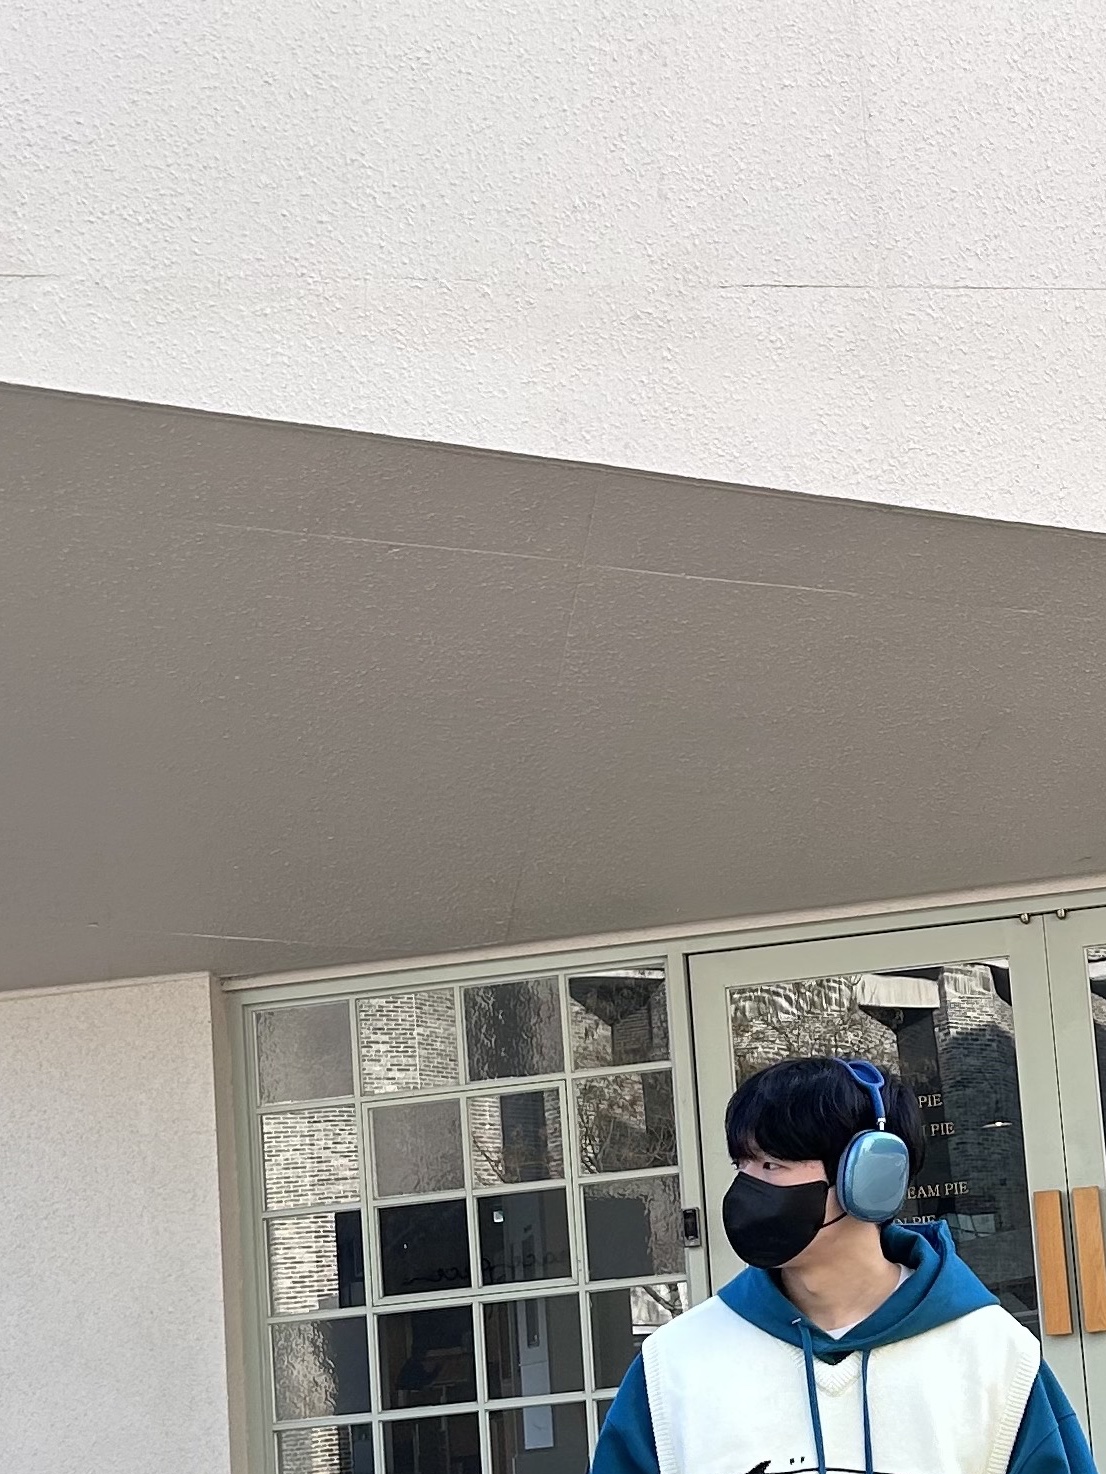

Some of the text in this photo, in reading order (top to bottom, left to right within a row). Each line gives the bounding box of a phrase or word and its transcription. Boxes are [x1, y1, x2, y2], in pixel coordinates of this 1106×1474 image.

[918, 1093, 943, 1108] PIE
[930, 1122, 955, 1136] PIE
[907, 1181, 969, 1199] EAM PIE
